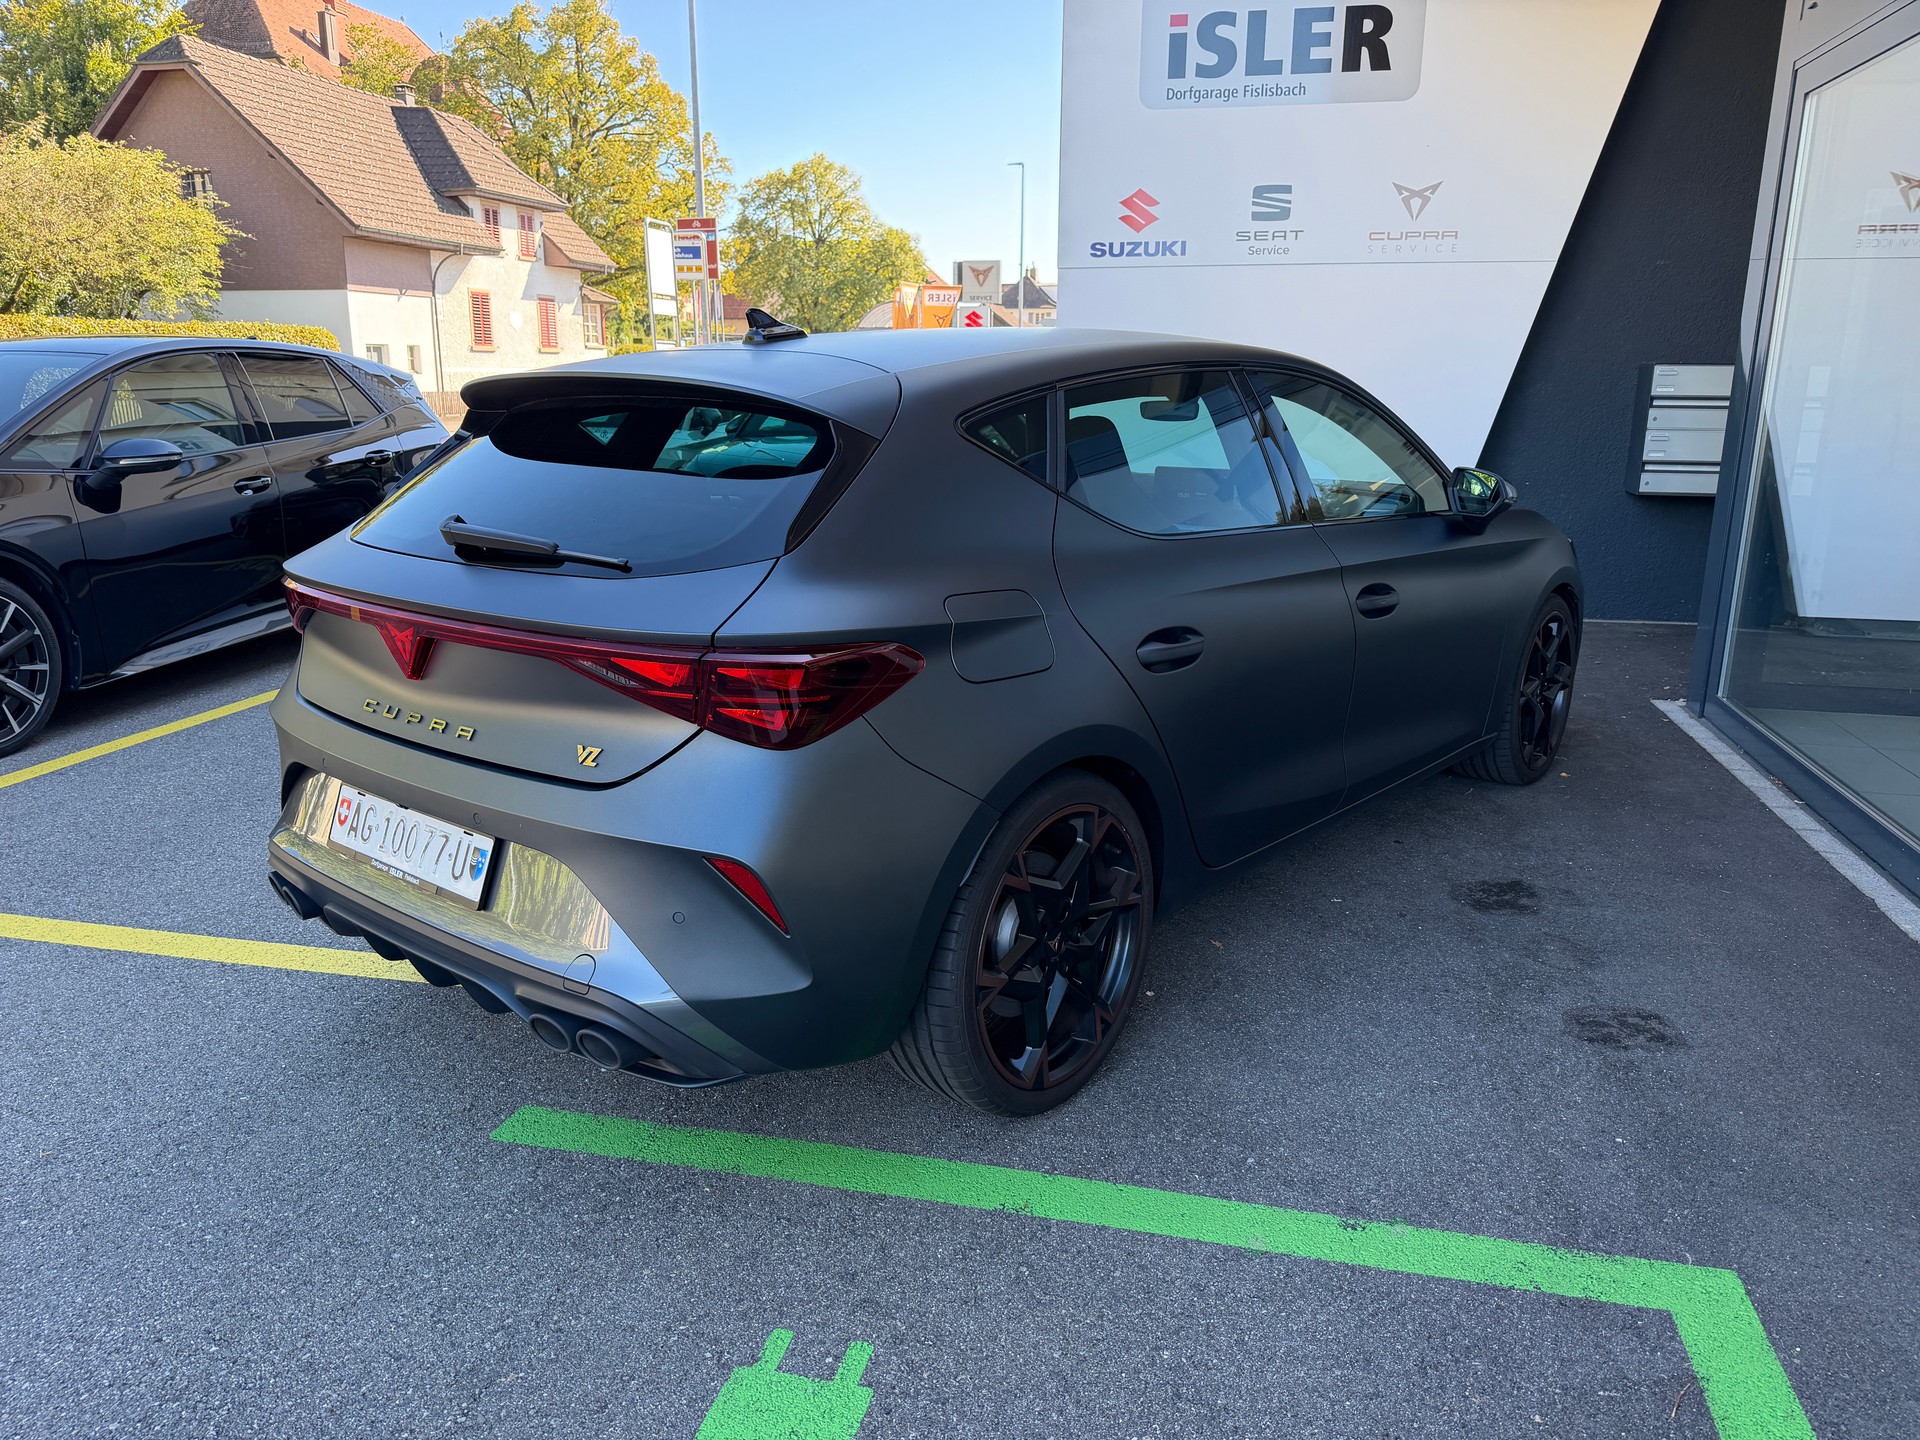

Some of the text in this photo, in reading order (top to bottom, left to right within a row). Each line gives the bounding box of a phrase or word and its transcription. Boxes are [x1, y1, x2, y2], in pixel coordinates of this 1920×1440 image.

[1165, 82, 1307, 104] Dorfgarage Fislisbach
[1236, 230, 1304, 242] SEAT
[1368, 230, 1459, 241] CUPRA
[1090, 240, 1187, 258] SUZUKI
[1247, 245, 1290, 256] Service
[1367, 243, 1458, 254] SERVICE
[362, 698, 476, 741] CUPRA
[576, 744, 603, 768] VZ
